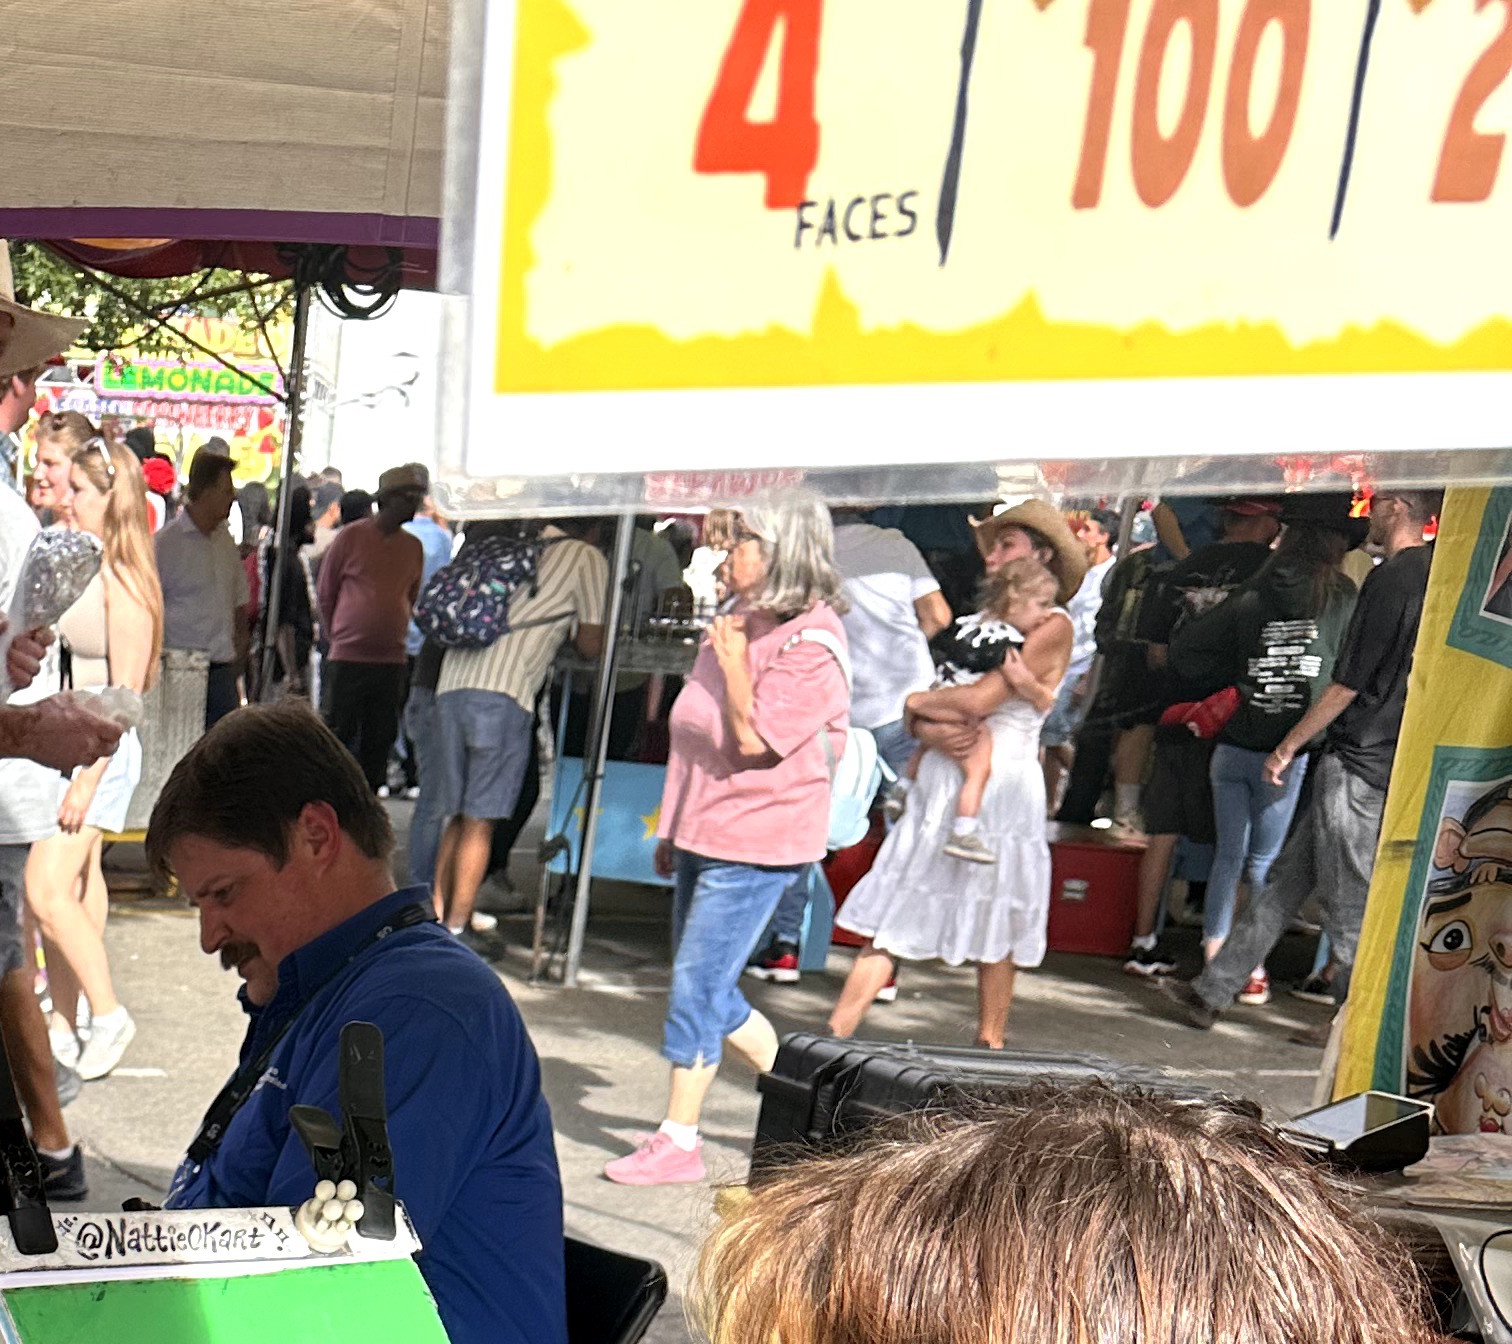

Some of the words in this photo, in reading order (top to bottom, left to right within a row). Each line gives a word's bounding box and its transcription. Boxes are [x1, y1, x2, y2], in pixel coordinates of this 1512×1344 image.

[692, 0, 821, 210] 4
[1031, 0, 1312, 210] 100
[794, 190, 919, 249] FACES
[101, 360, 275, 395] LEMONADE
